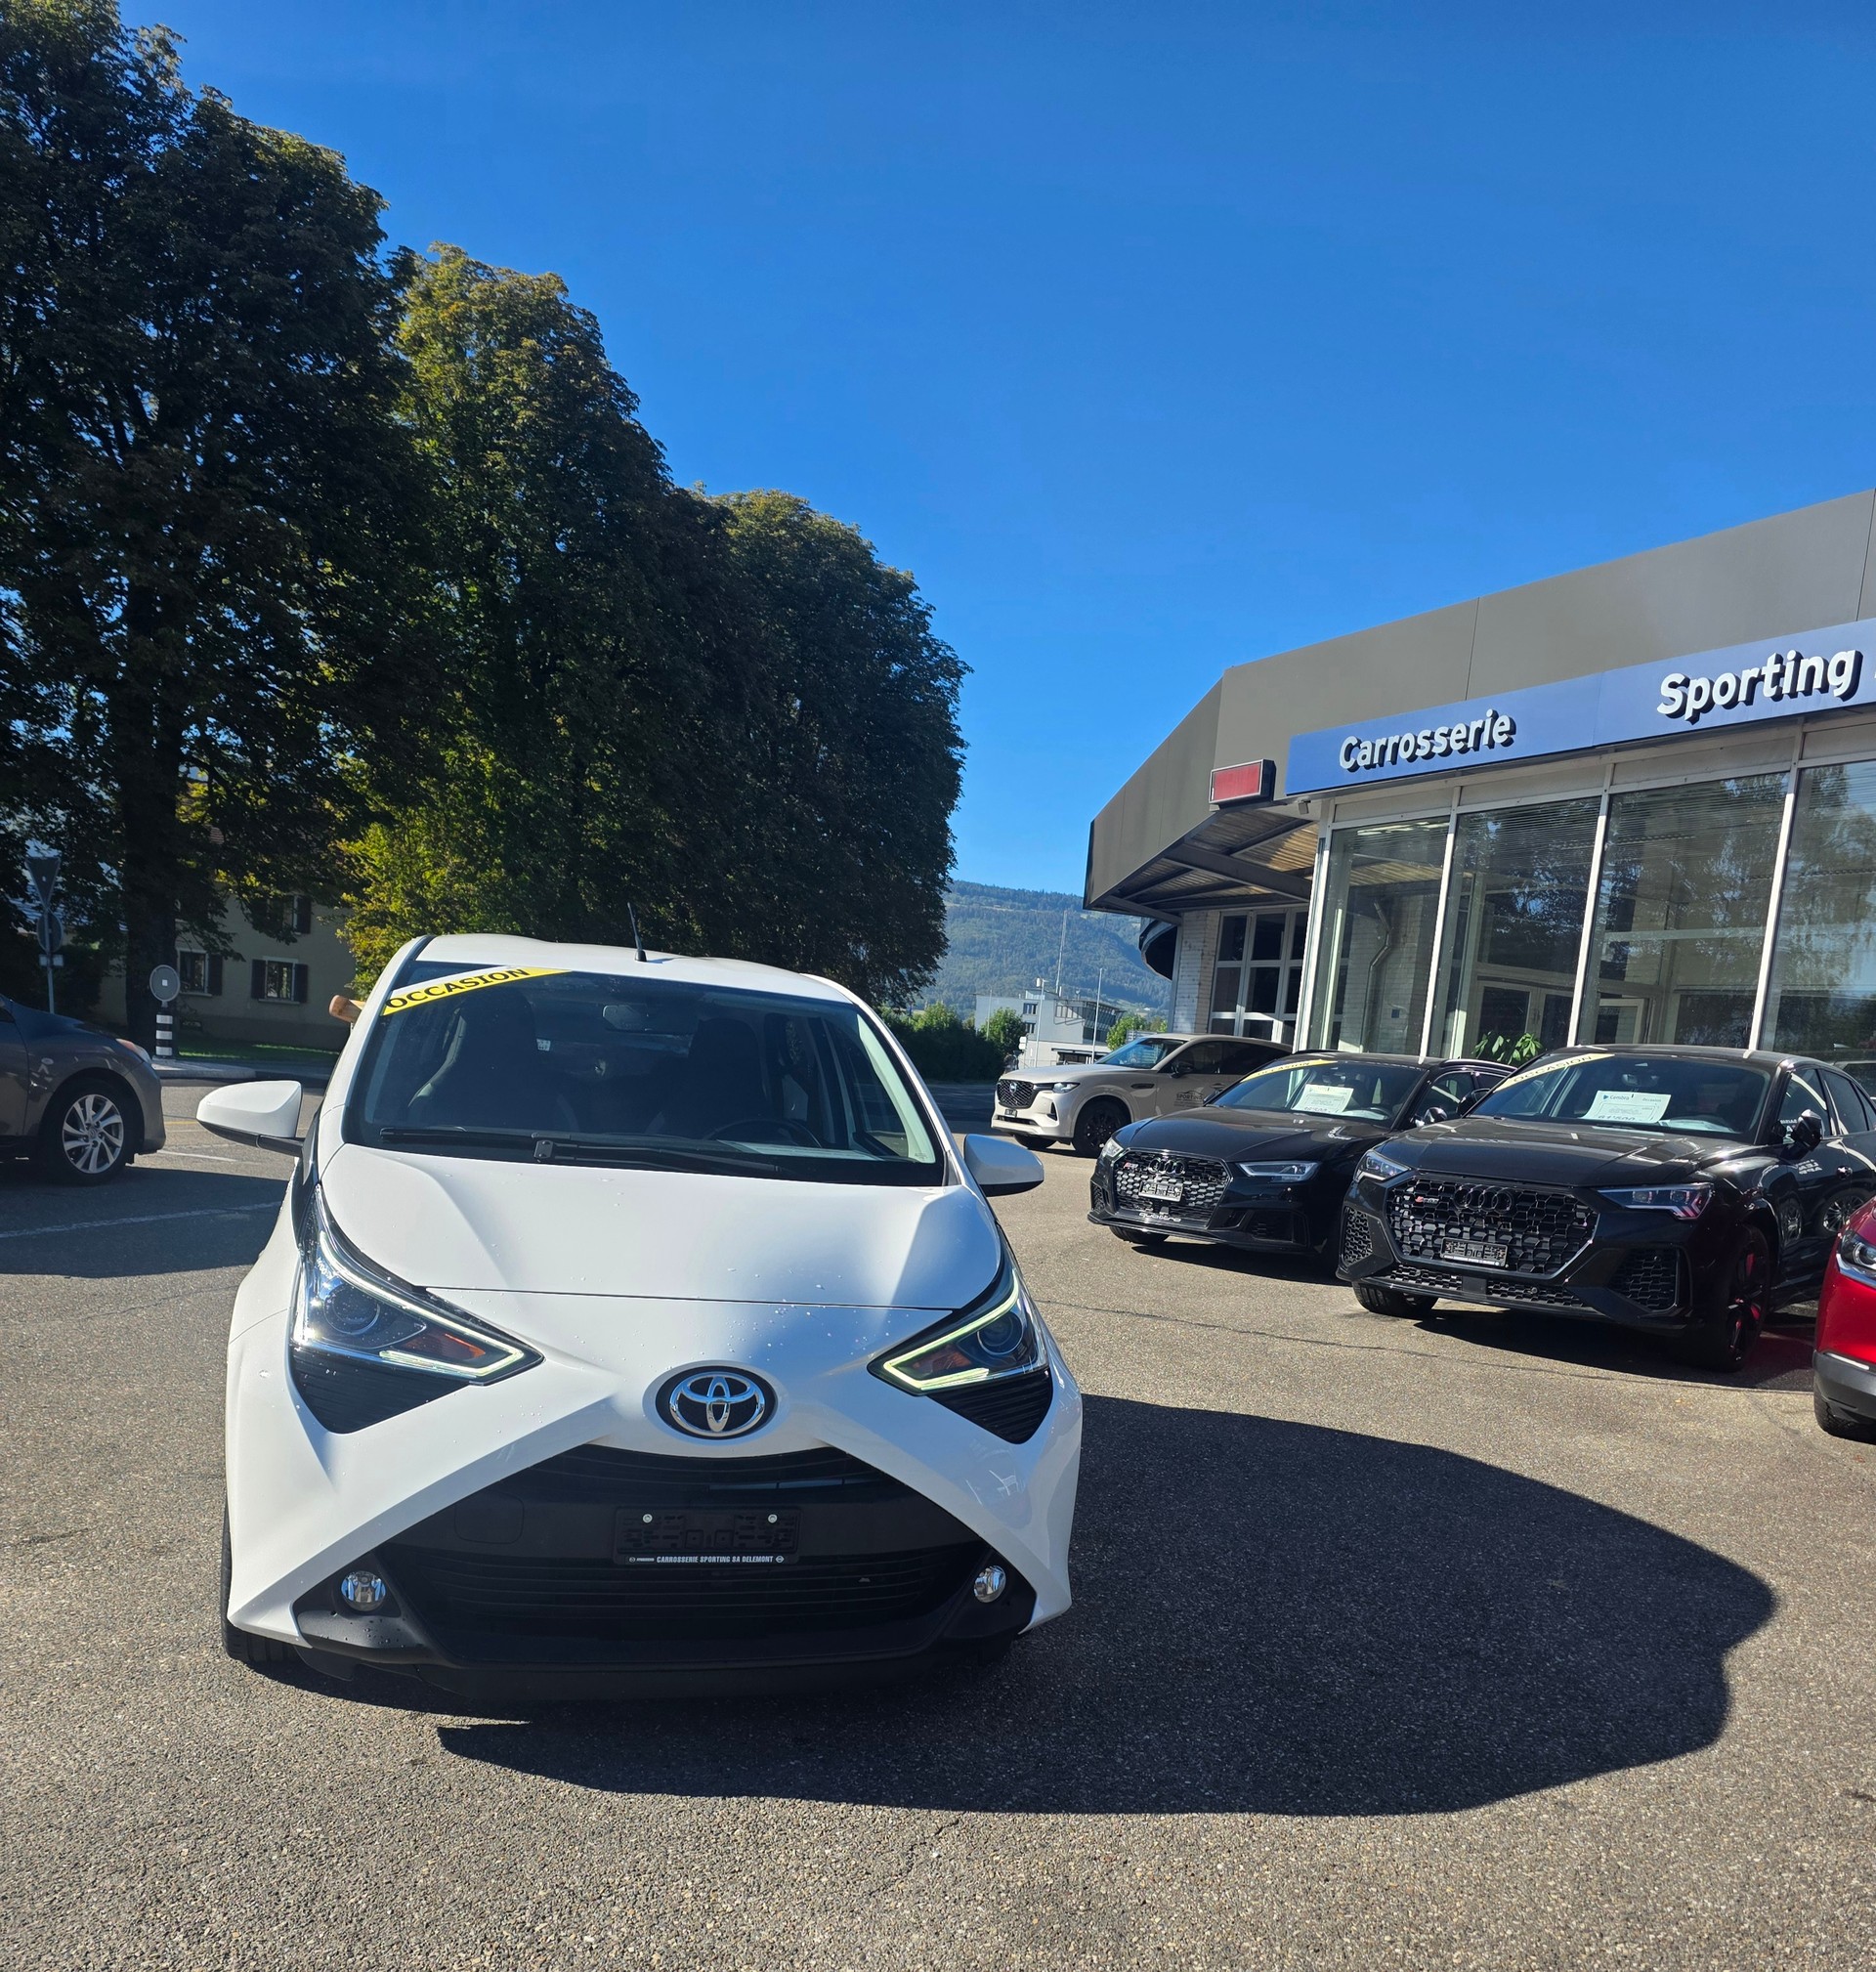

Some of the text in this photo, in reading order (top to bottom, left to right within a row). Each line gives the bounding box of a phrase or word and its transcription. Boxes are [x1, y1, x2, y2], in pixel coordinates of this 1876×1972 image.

[1339, 649, 1860, 771] Carrosserie Sporting
[386, 967, 530, 1008] OCCASION
[1514, 1055, 1593, 1083] OCCASION
